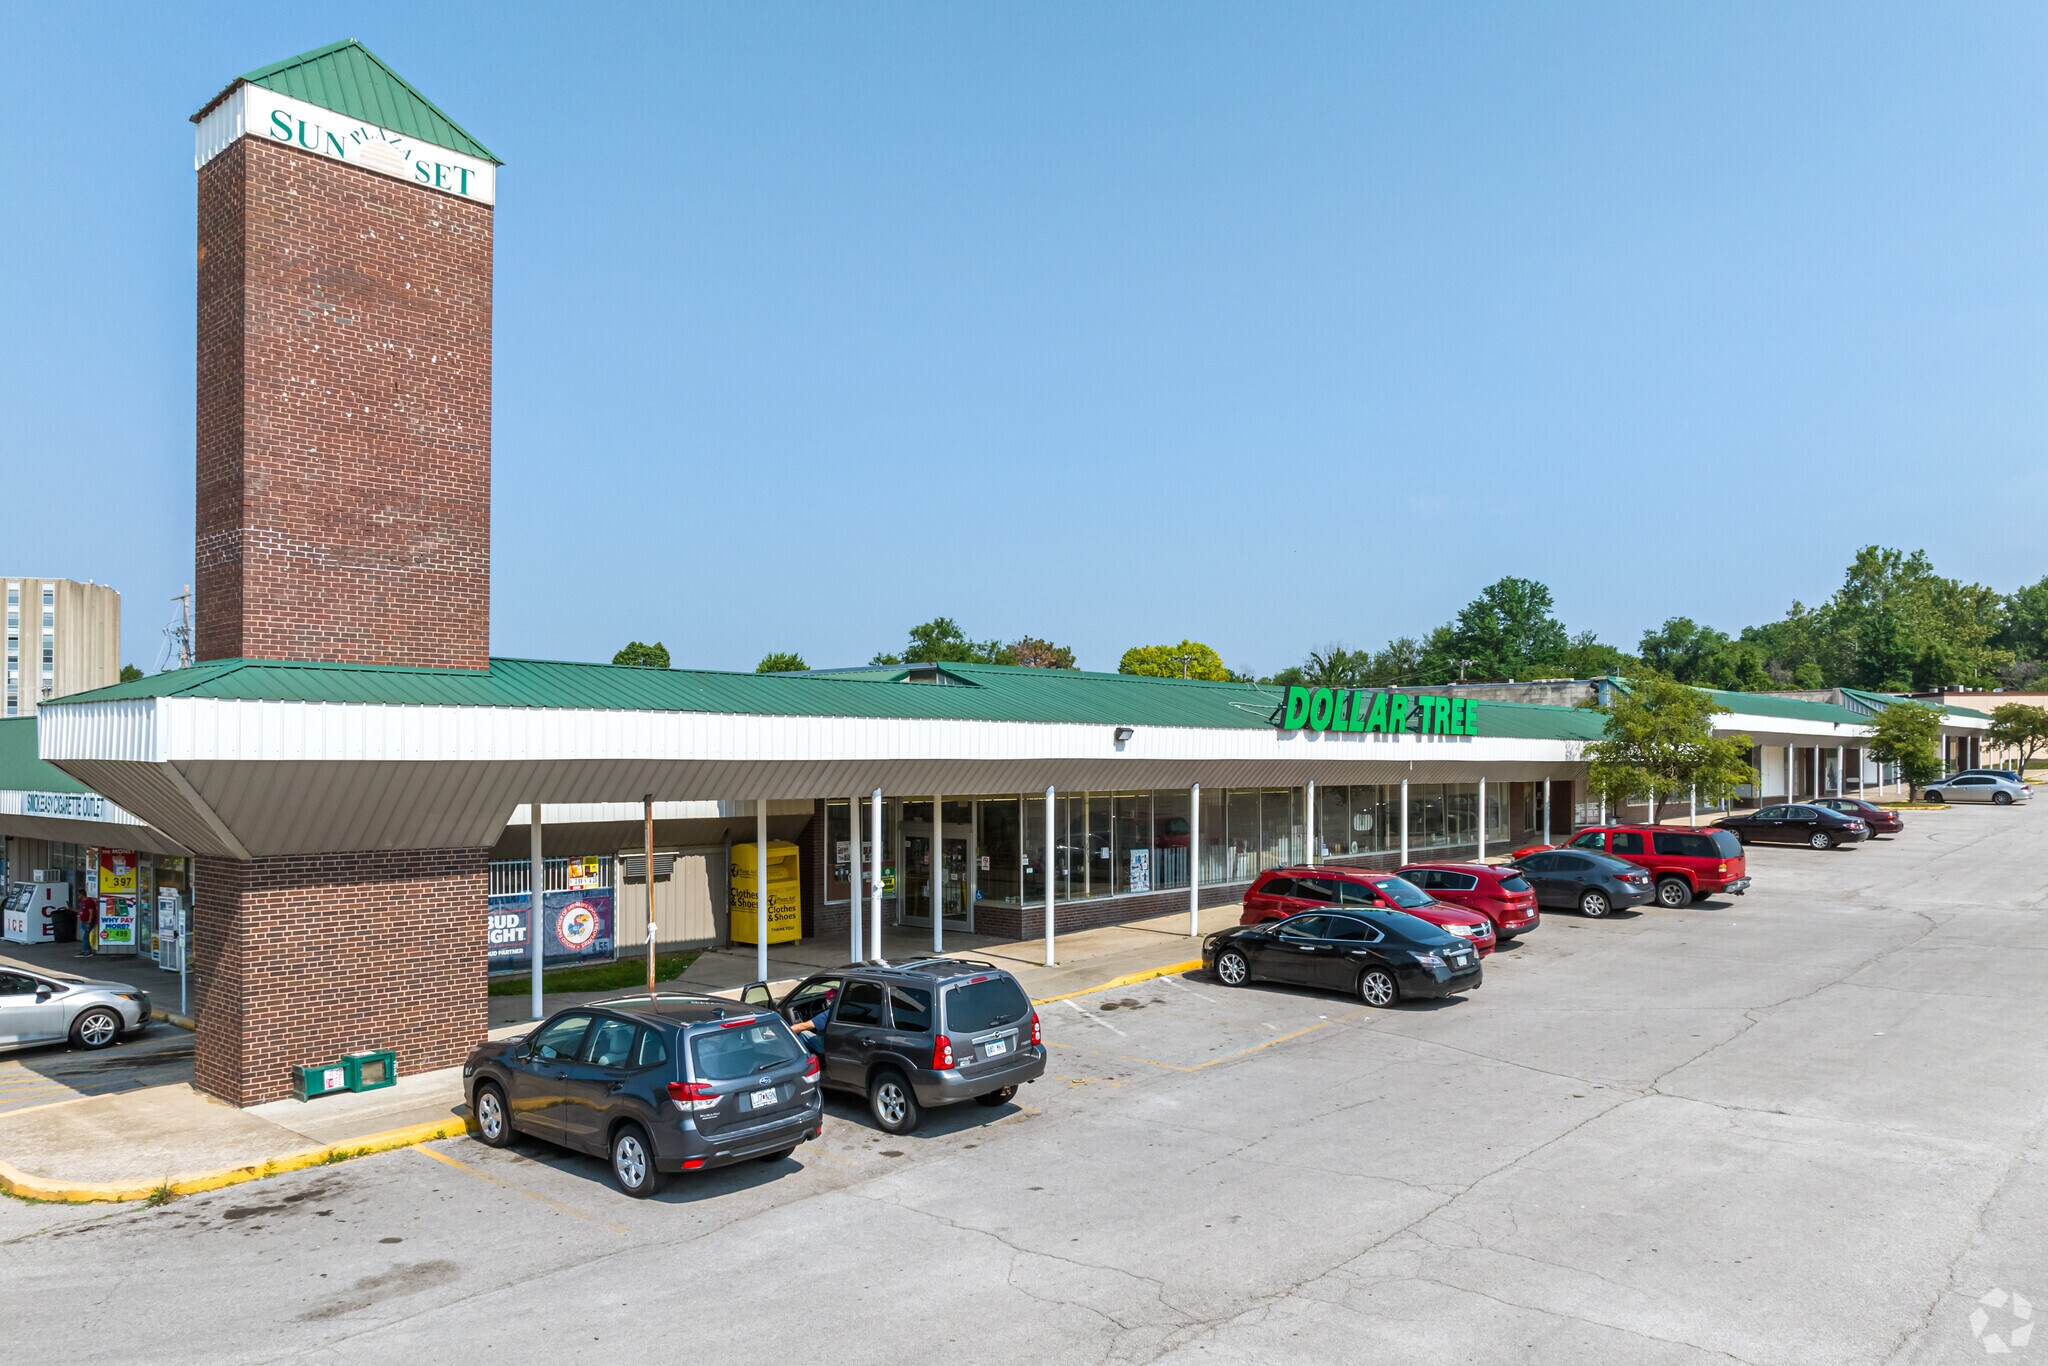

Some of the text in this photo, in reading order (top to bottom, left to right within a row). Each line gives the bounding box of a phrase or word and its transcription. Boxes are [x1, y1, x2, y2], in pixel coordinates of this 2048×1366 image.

[350, 126, 413, 161] PLAZA
[269, 109, 476, 197] SUN SET
[1281, 685, 1479, 737] DOLLAR TREE
[53, 795, 82, 817] CIGARETTE
[83, 796, 105, 818] OUTLET
[731, 887, 758, 900] Clothes
[768, 905, 796, 914] Clothes
[768, 913, 797, 922] & Shoes
[7, 918, 24, 933] ICE
[498, 948, 524, 956] PARTNER
